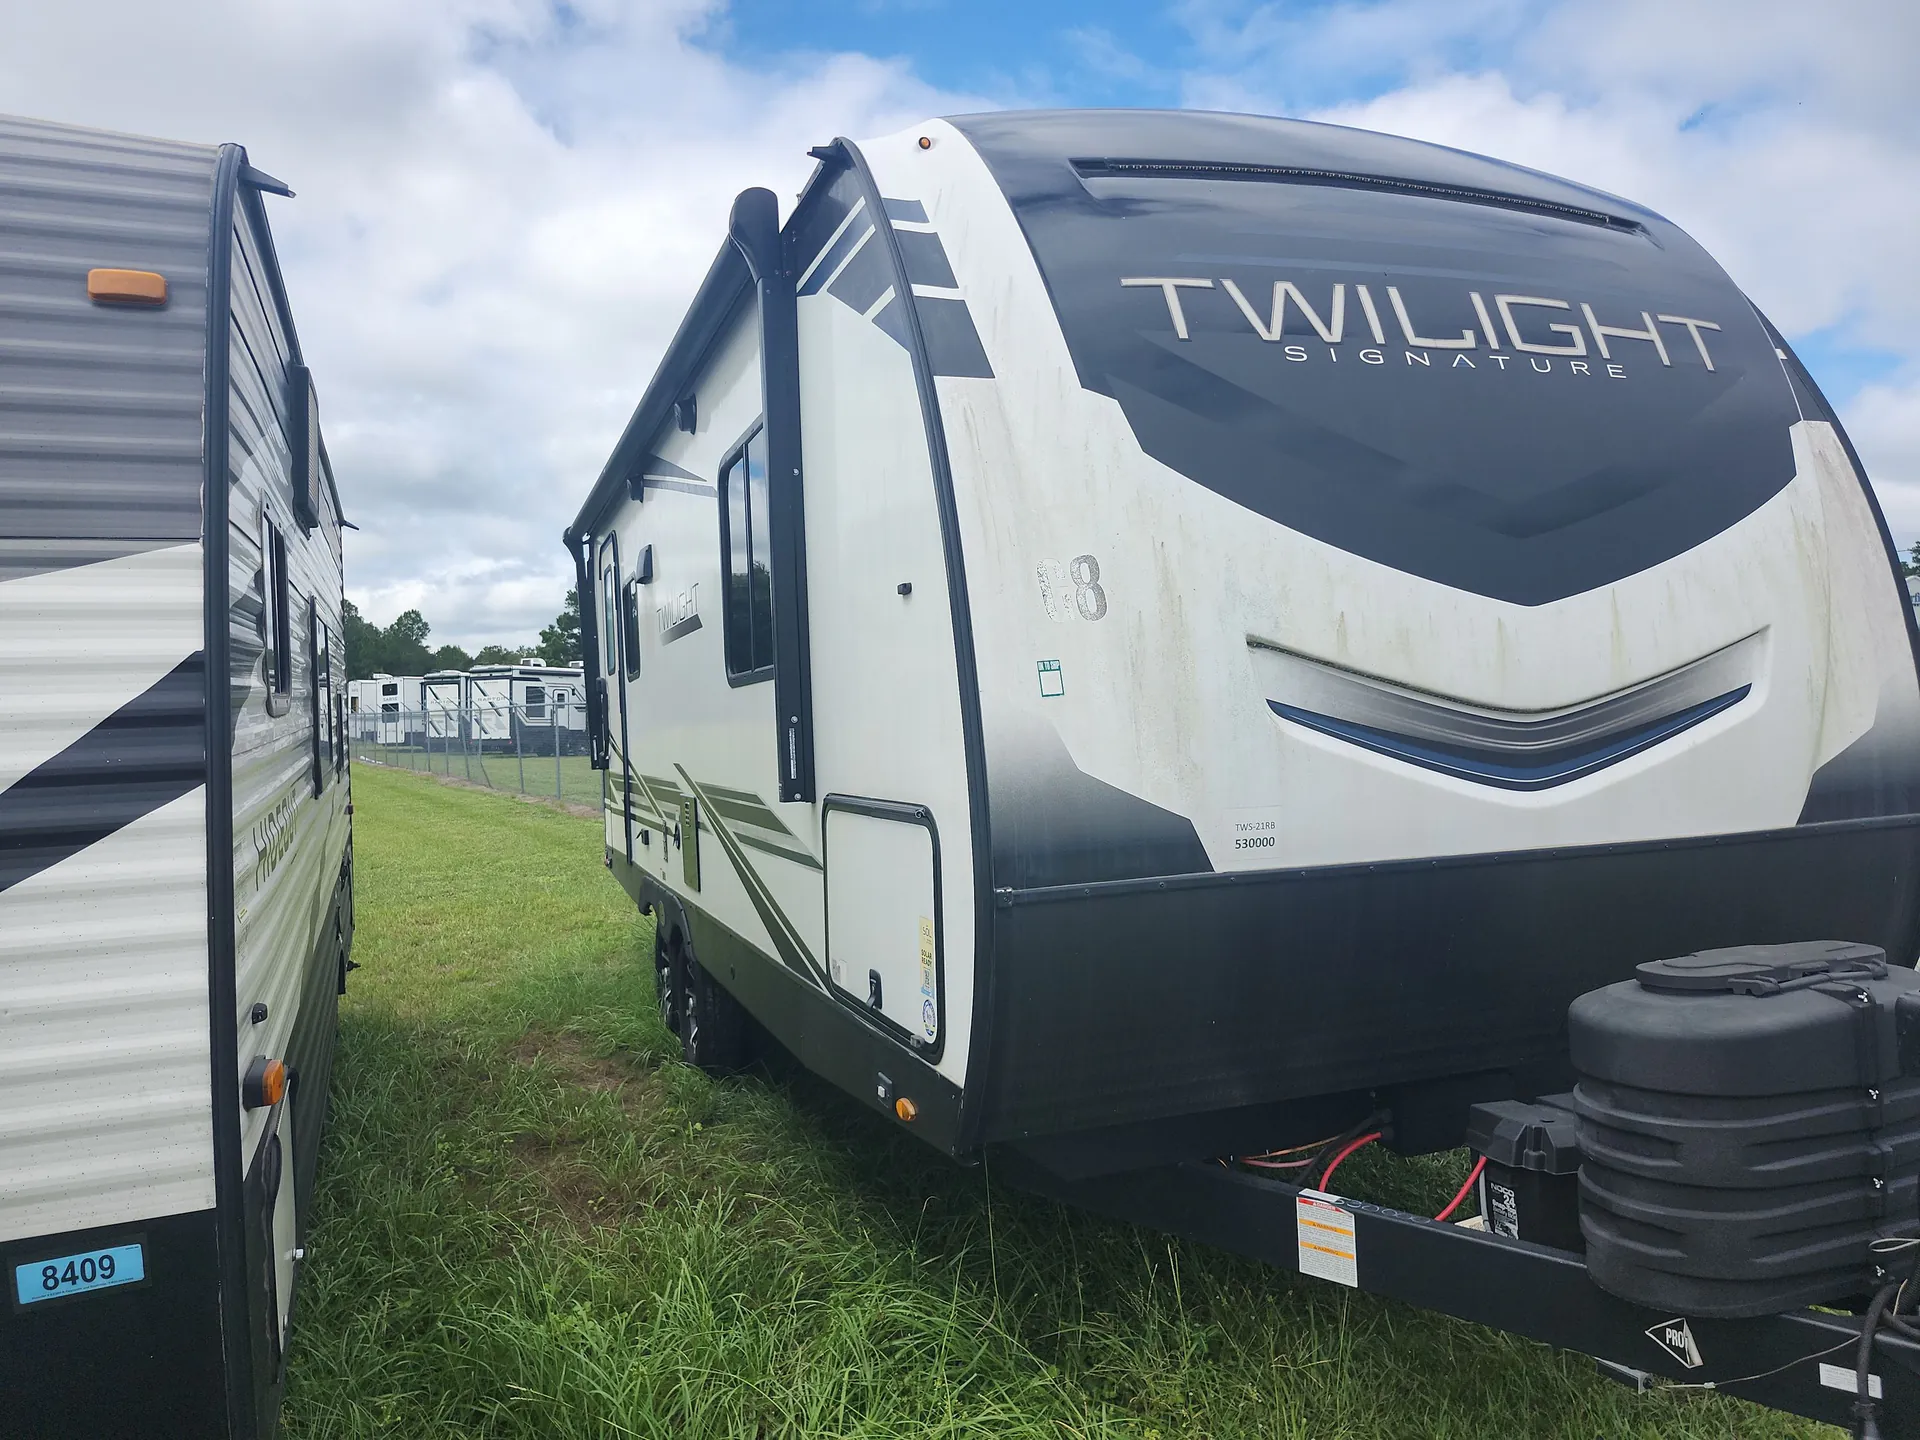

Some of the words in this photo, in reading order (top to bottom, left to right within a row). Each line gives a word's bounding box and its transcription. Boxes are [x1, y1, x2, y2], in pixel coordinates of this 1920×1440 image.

[1119, 277, 1722, 373] TWILIGHT
[1284, 345, 1627, 380] SIGNATURE
[656, 582, 699, 634] TWILIGHT
[252, 788, 299, 892] HIDEOUT
[1235, 821, 1276, 831] TWS-21RB
[1235, 836, 1276, 850] 530000
[1490, 1182, 1515, 1198] NOCO
[1503, 1194, 1516, 1208] 24
[41, 1254, 116, 1291] 8409
